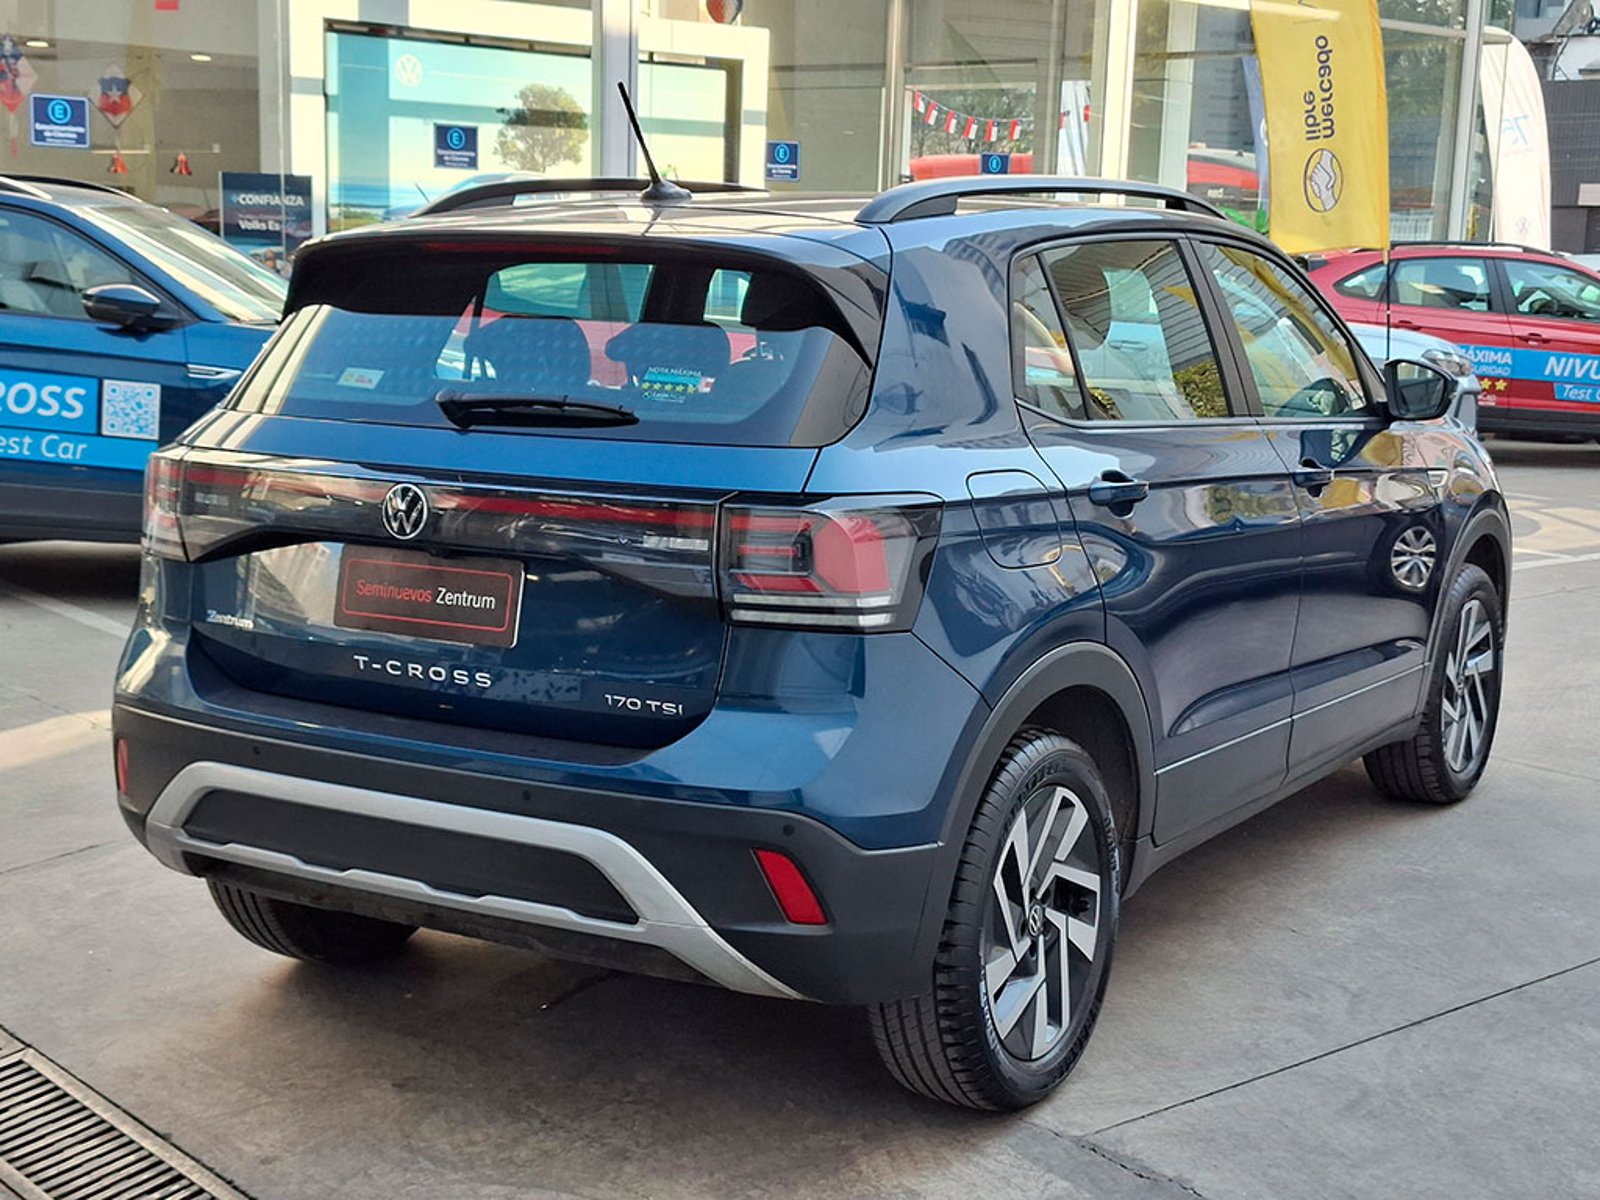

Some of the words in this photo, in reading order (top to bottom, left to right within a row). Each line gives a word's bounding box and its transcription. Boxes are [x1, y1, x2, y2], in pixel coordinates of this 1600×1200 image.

[0, 382, 86, 419] OSS
[1563, 385, 1592, 401] Test
[41, 435, 87, 460] Car
[356, 578, 432, 603] Seminuevos
[436, 587, 496, 609] Zentrum
[353, 655, 493, 688] T-CROSS
[604, 693, 641, 711] 170
[646, 700, 683, 716] TSI
